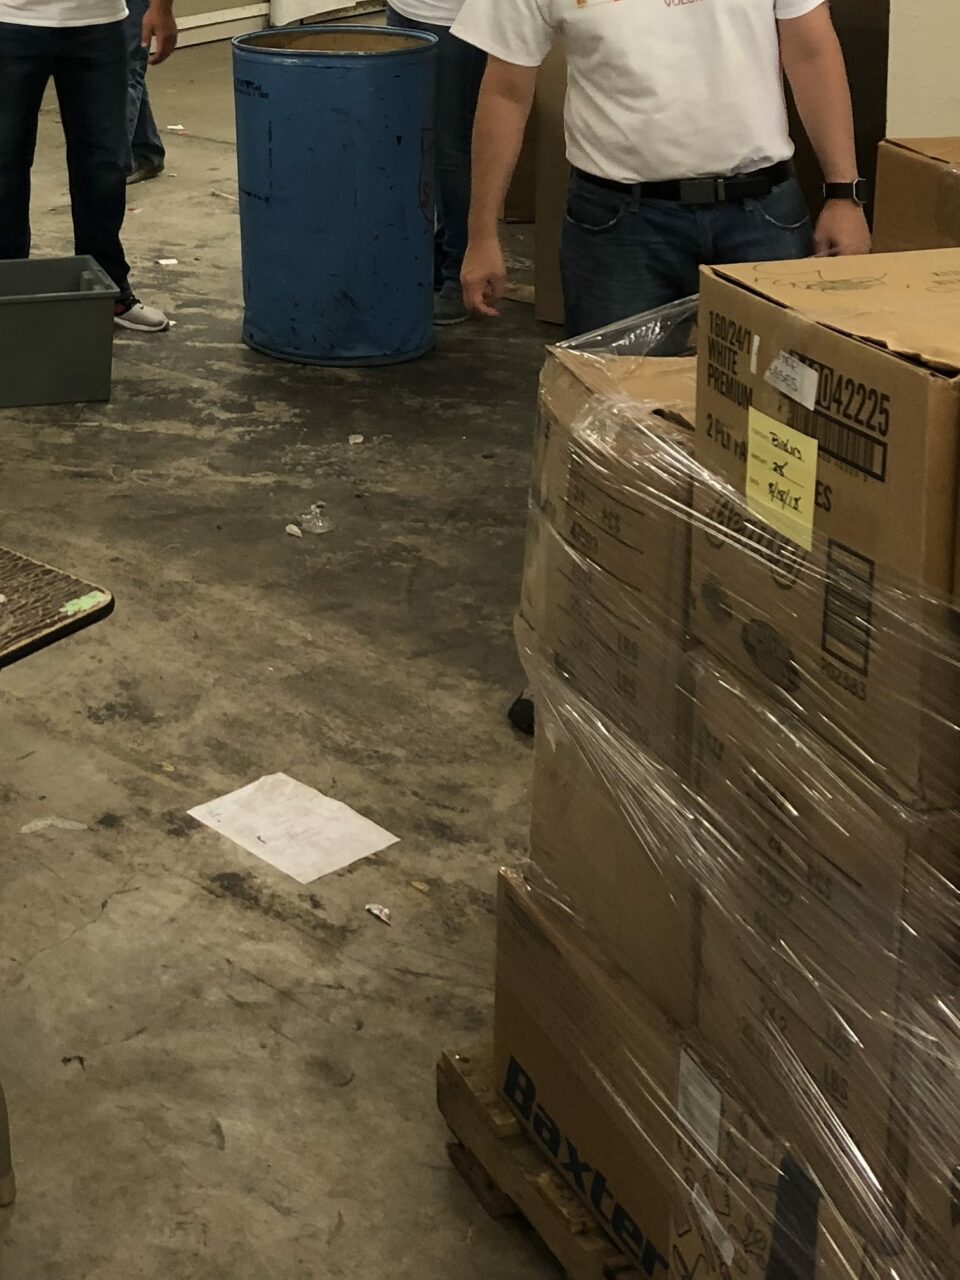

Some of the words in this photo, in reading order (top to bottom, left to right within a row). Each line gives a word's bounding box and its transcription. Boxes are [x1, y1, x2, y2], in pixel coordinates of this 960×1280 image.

[707, 335, 738, 376] WHITE
[707, 362, 753, 411] PREMIUM
[502, 1053, 670, 1278] Baxter
